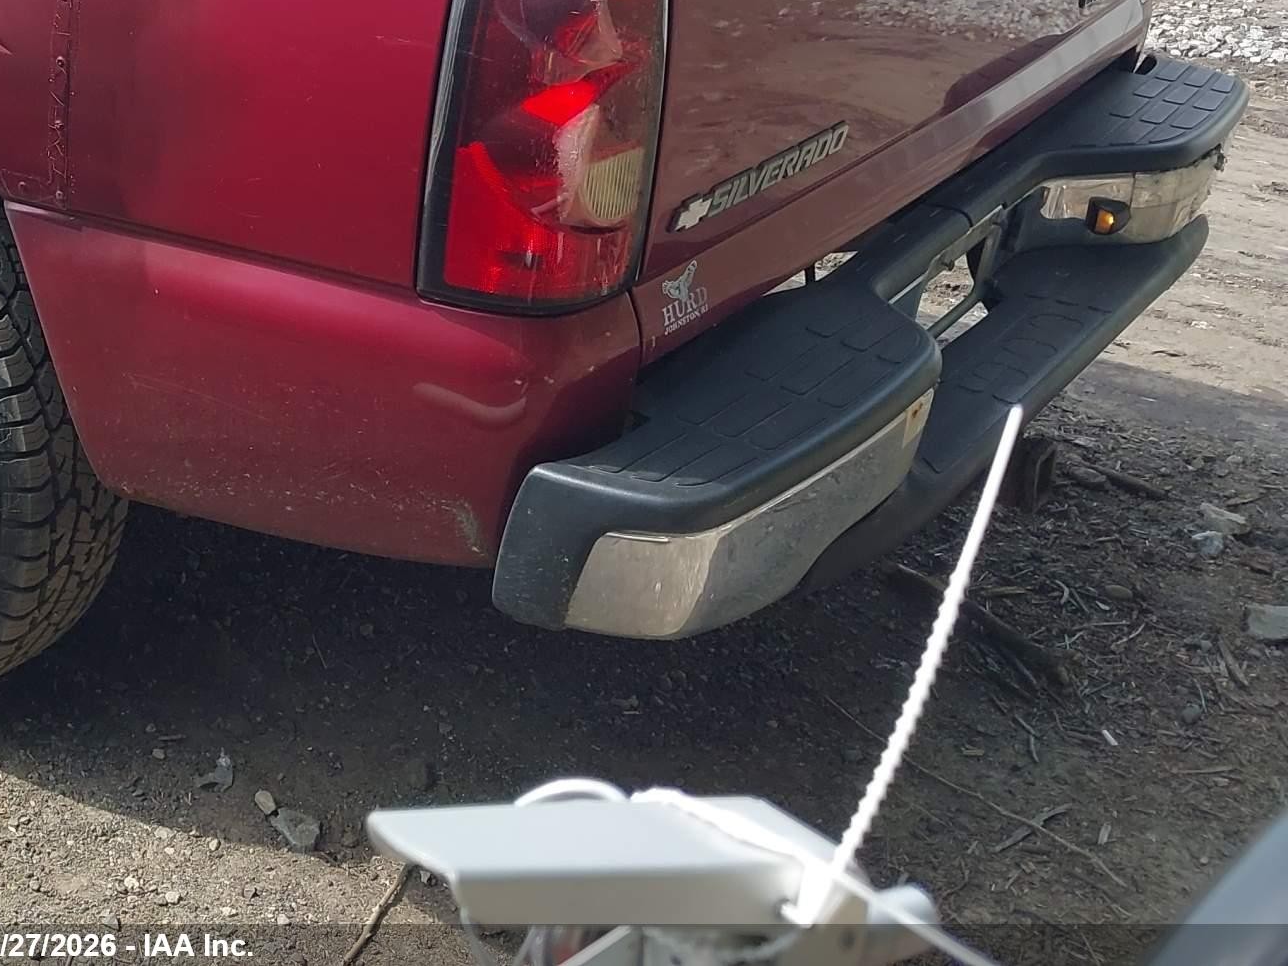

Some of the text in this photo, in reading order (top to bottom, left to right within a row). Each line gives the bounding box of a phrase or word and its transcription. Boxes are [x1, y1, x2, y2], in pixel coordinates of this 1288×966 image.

[708, 121, 850, 218] SILVERADO
[661, 286, 708, 327] HURD
[664, 310, 701, 336] JOHNSTON
